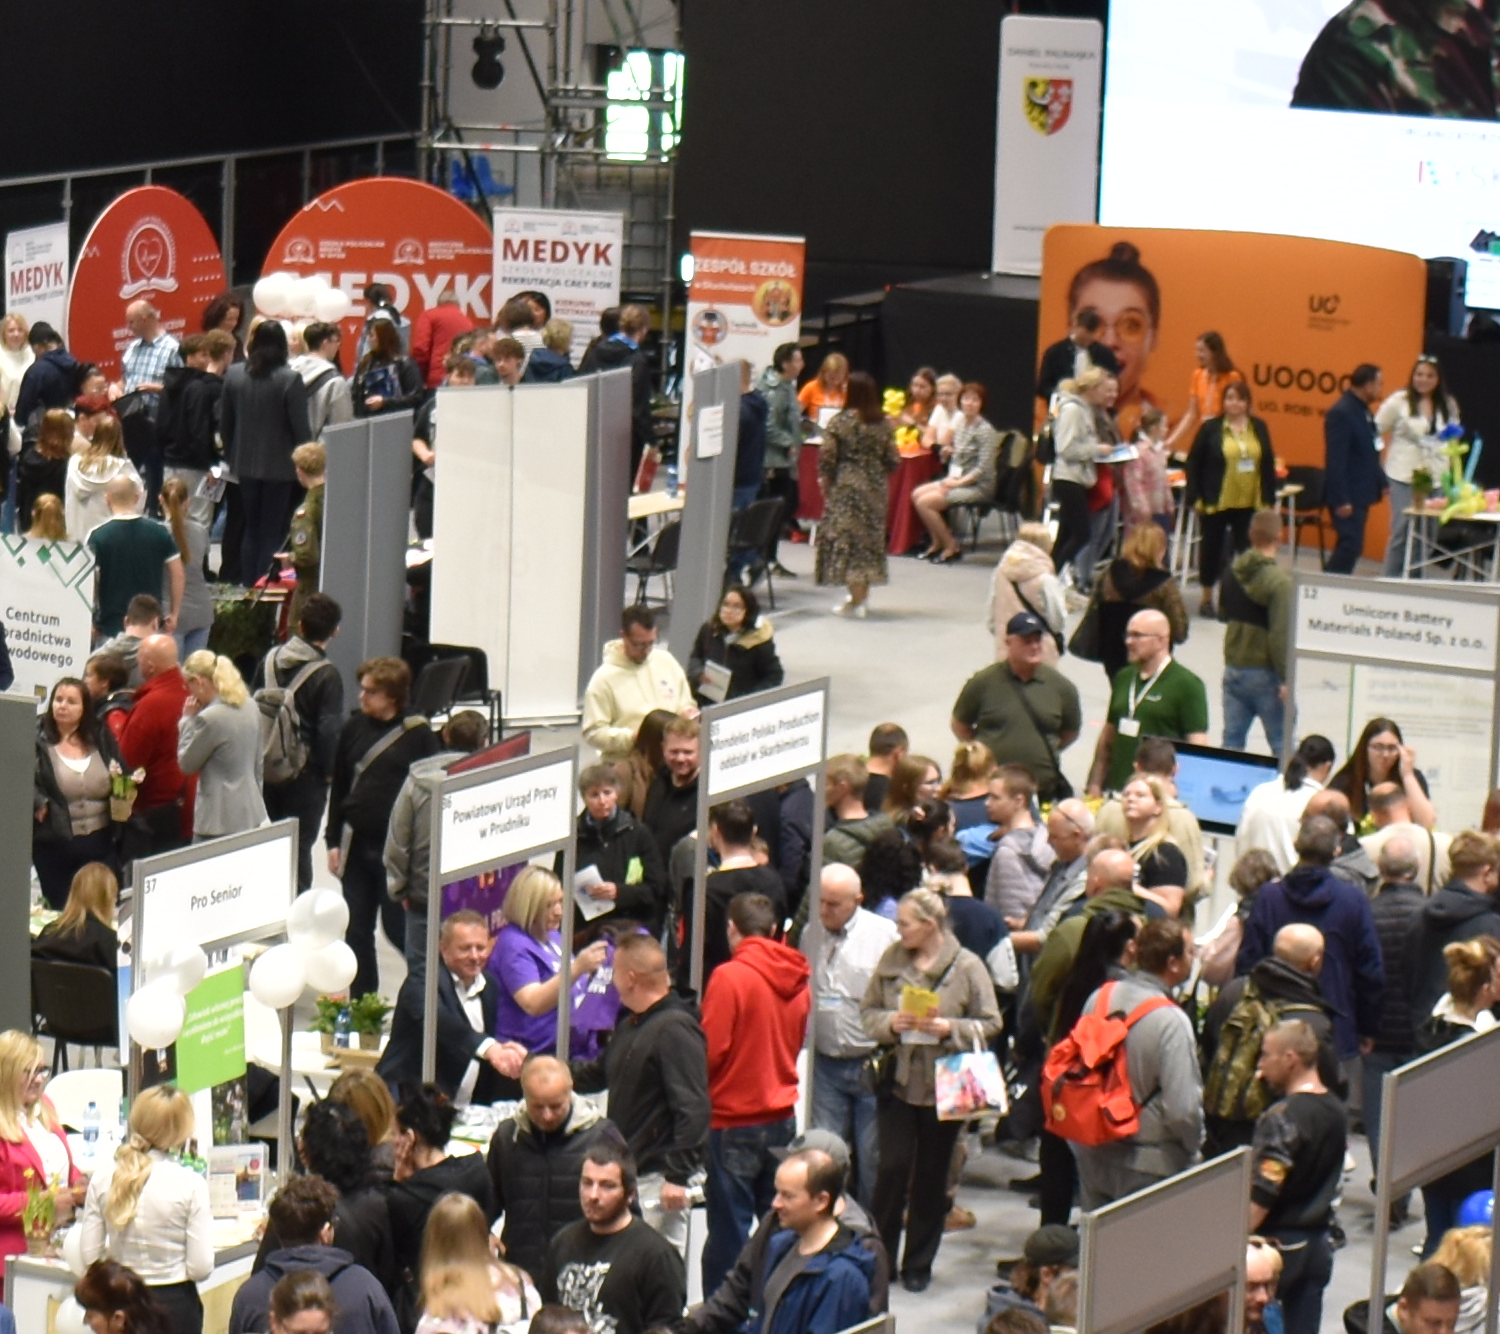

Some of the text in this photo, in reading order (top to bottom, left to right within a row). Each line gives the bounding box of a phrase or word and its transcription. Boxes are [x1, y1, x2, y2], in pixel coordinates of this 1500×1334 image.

[503, 238, 612, 266] MEDYK
[10, 262, 64, 296] MEDYK
[1303, 587, 1319, 600] 12
[6, 607, 60, 627] Centrum
[1342, 603, 1454, 630] Umicore Battery
[4, 628, 72, 649] oradnictwa
[1307, 617, 1445, 648] Materials Poland Sp.
[777, 711, 820, 736] Production
[453, 786, 559, 825] Powiatowy Urząd Pracy
[489, 815, 531, 840] Prudniku
[144, 878, 158, 896] 37
[190, 883, 243, 912] Pro Senior
